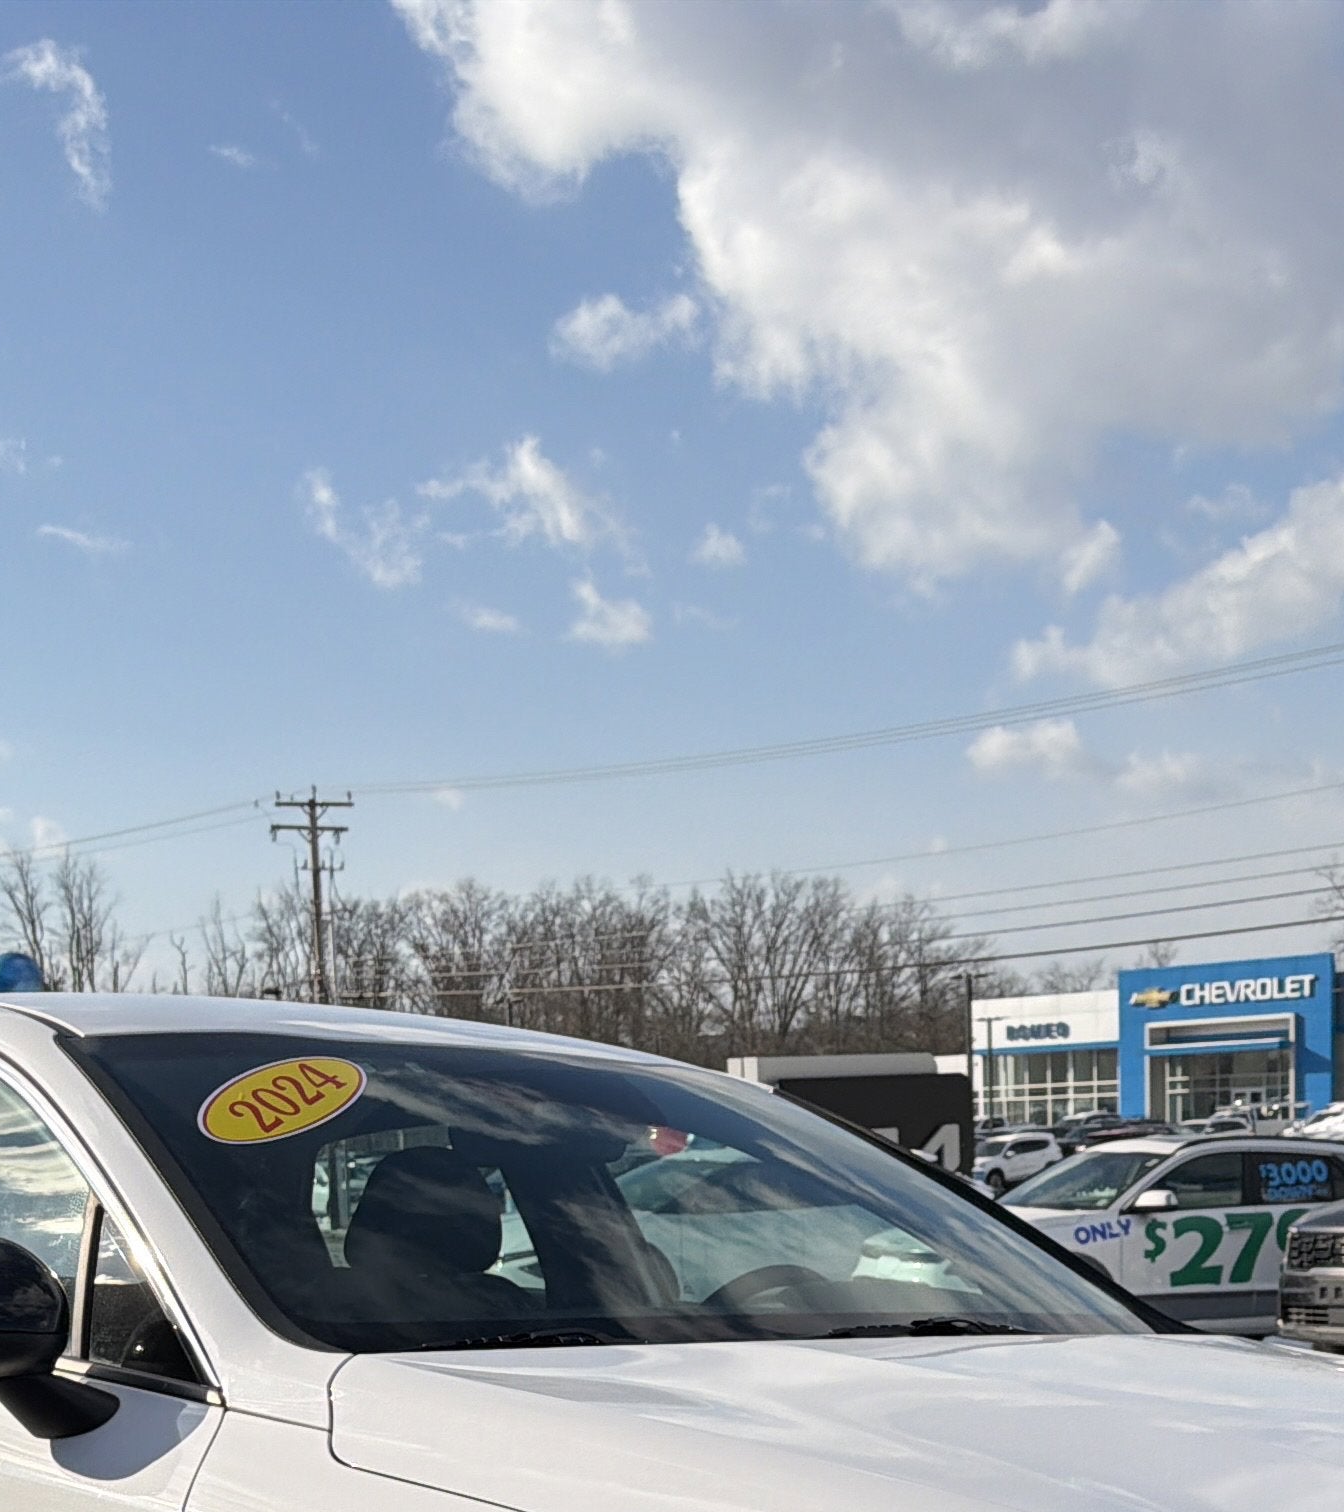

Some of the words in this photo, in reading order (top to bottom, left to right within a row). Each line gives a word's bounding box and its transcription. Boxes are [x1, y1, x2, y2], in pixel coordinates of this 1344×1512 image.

[1179, 974, 1317, 1007] CHEVROLET
[228, 1063, 348, 1134] 2024
[1074, 1219, 1132, 1245] ONLY
